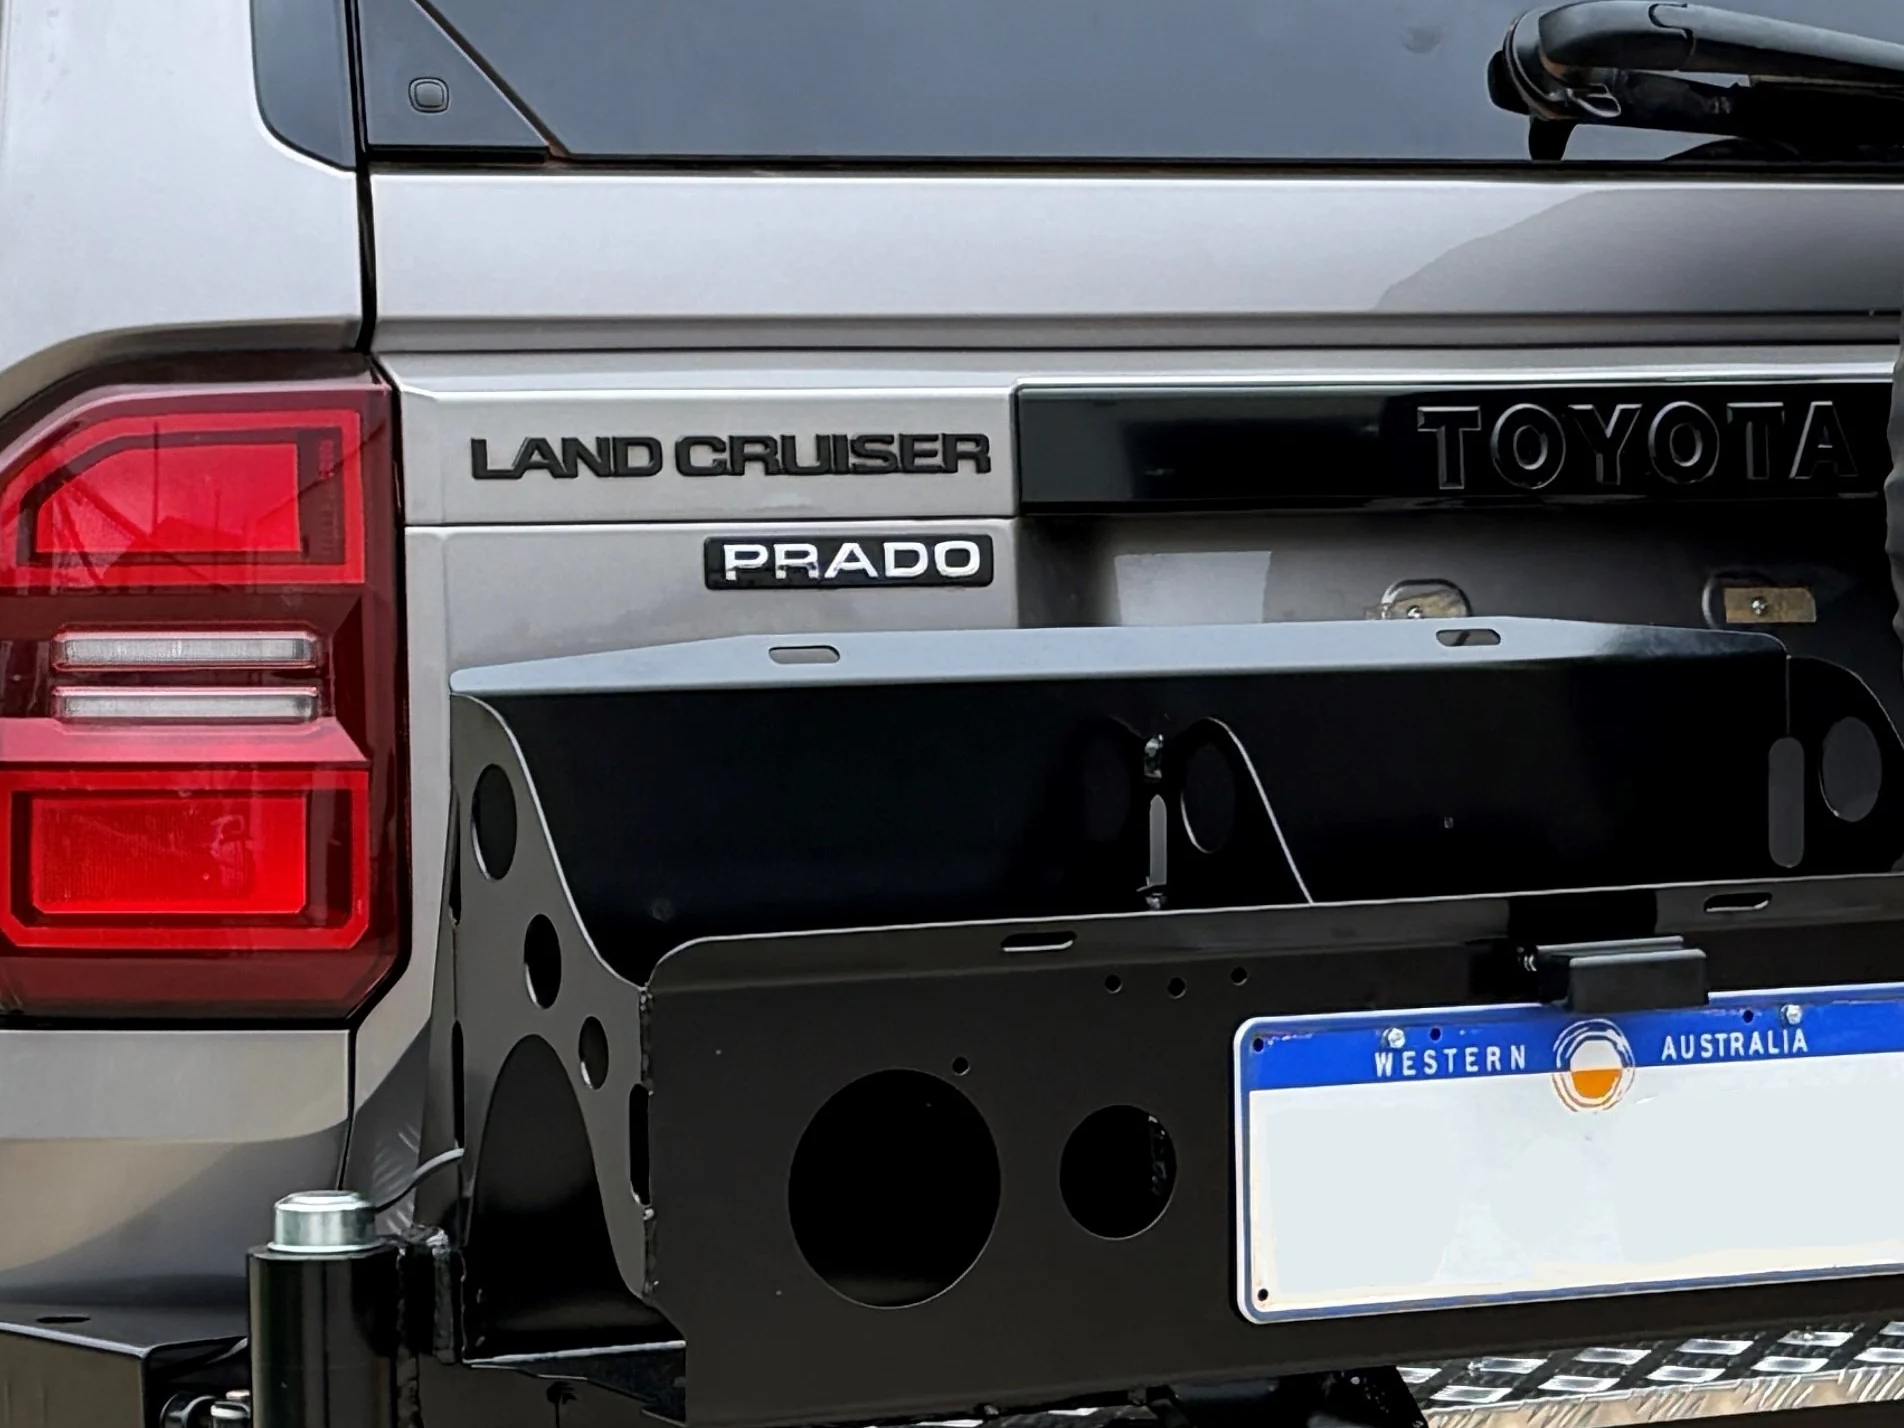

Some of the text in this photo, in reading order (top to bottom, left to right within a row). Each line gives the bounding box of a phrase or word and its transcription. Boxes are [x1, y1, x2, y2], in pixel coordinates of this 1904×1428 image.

[470, 433, 992, 479] LAND CRUISER
[1416, 401, 1859, 490] TOYOTA
[724, 540, 982, 582] PRADO
[1374, 1028, 1809, 1078] WESTERN AUSTRALIA
